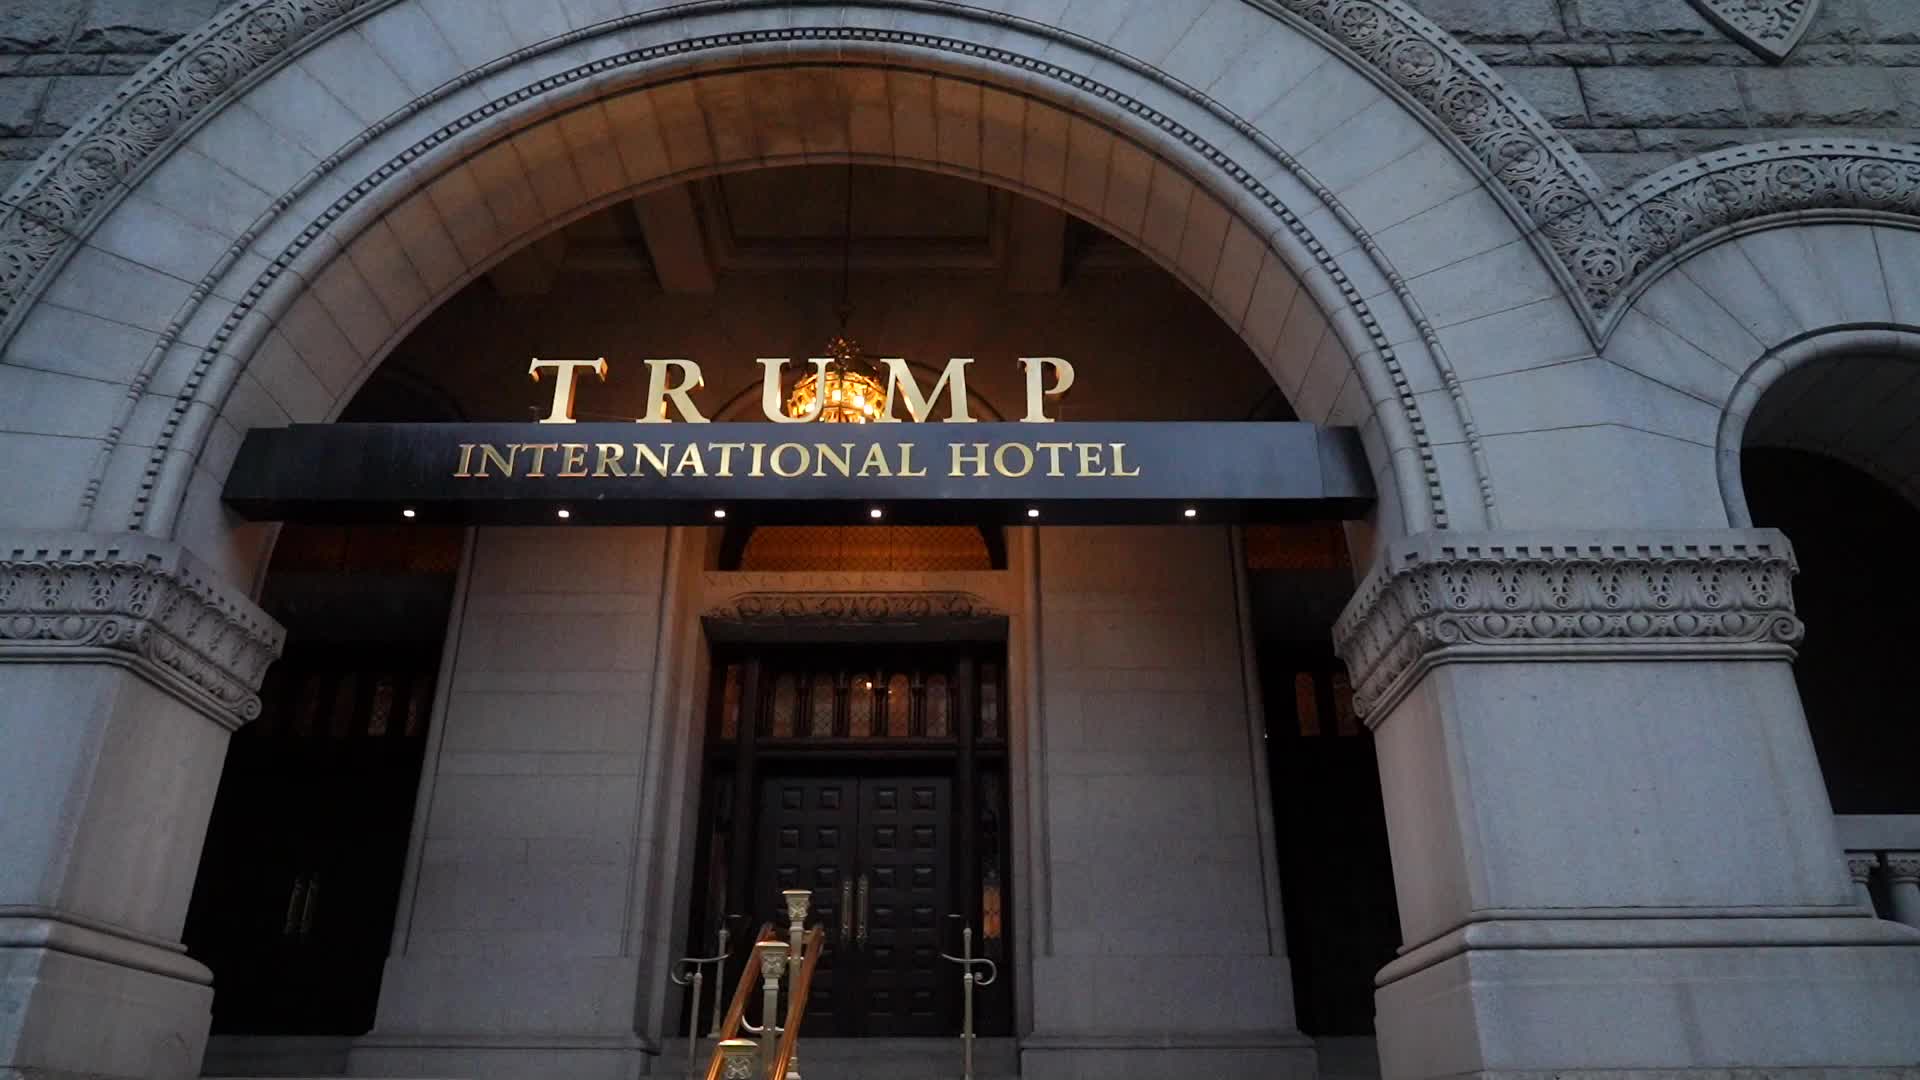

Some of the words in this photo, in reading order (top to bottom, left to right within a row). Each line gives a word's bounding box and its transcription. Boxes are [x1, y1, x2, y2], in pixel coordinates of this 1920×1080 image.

[528, 357, 1075, 424] TRUMP
[453, 442, 927, 477] INTERNATIONAL
[948, 442, 1141, 477] HOTEL
